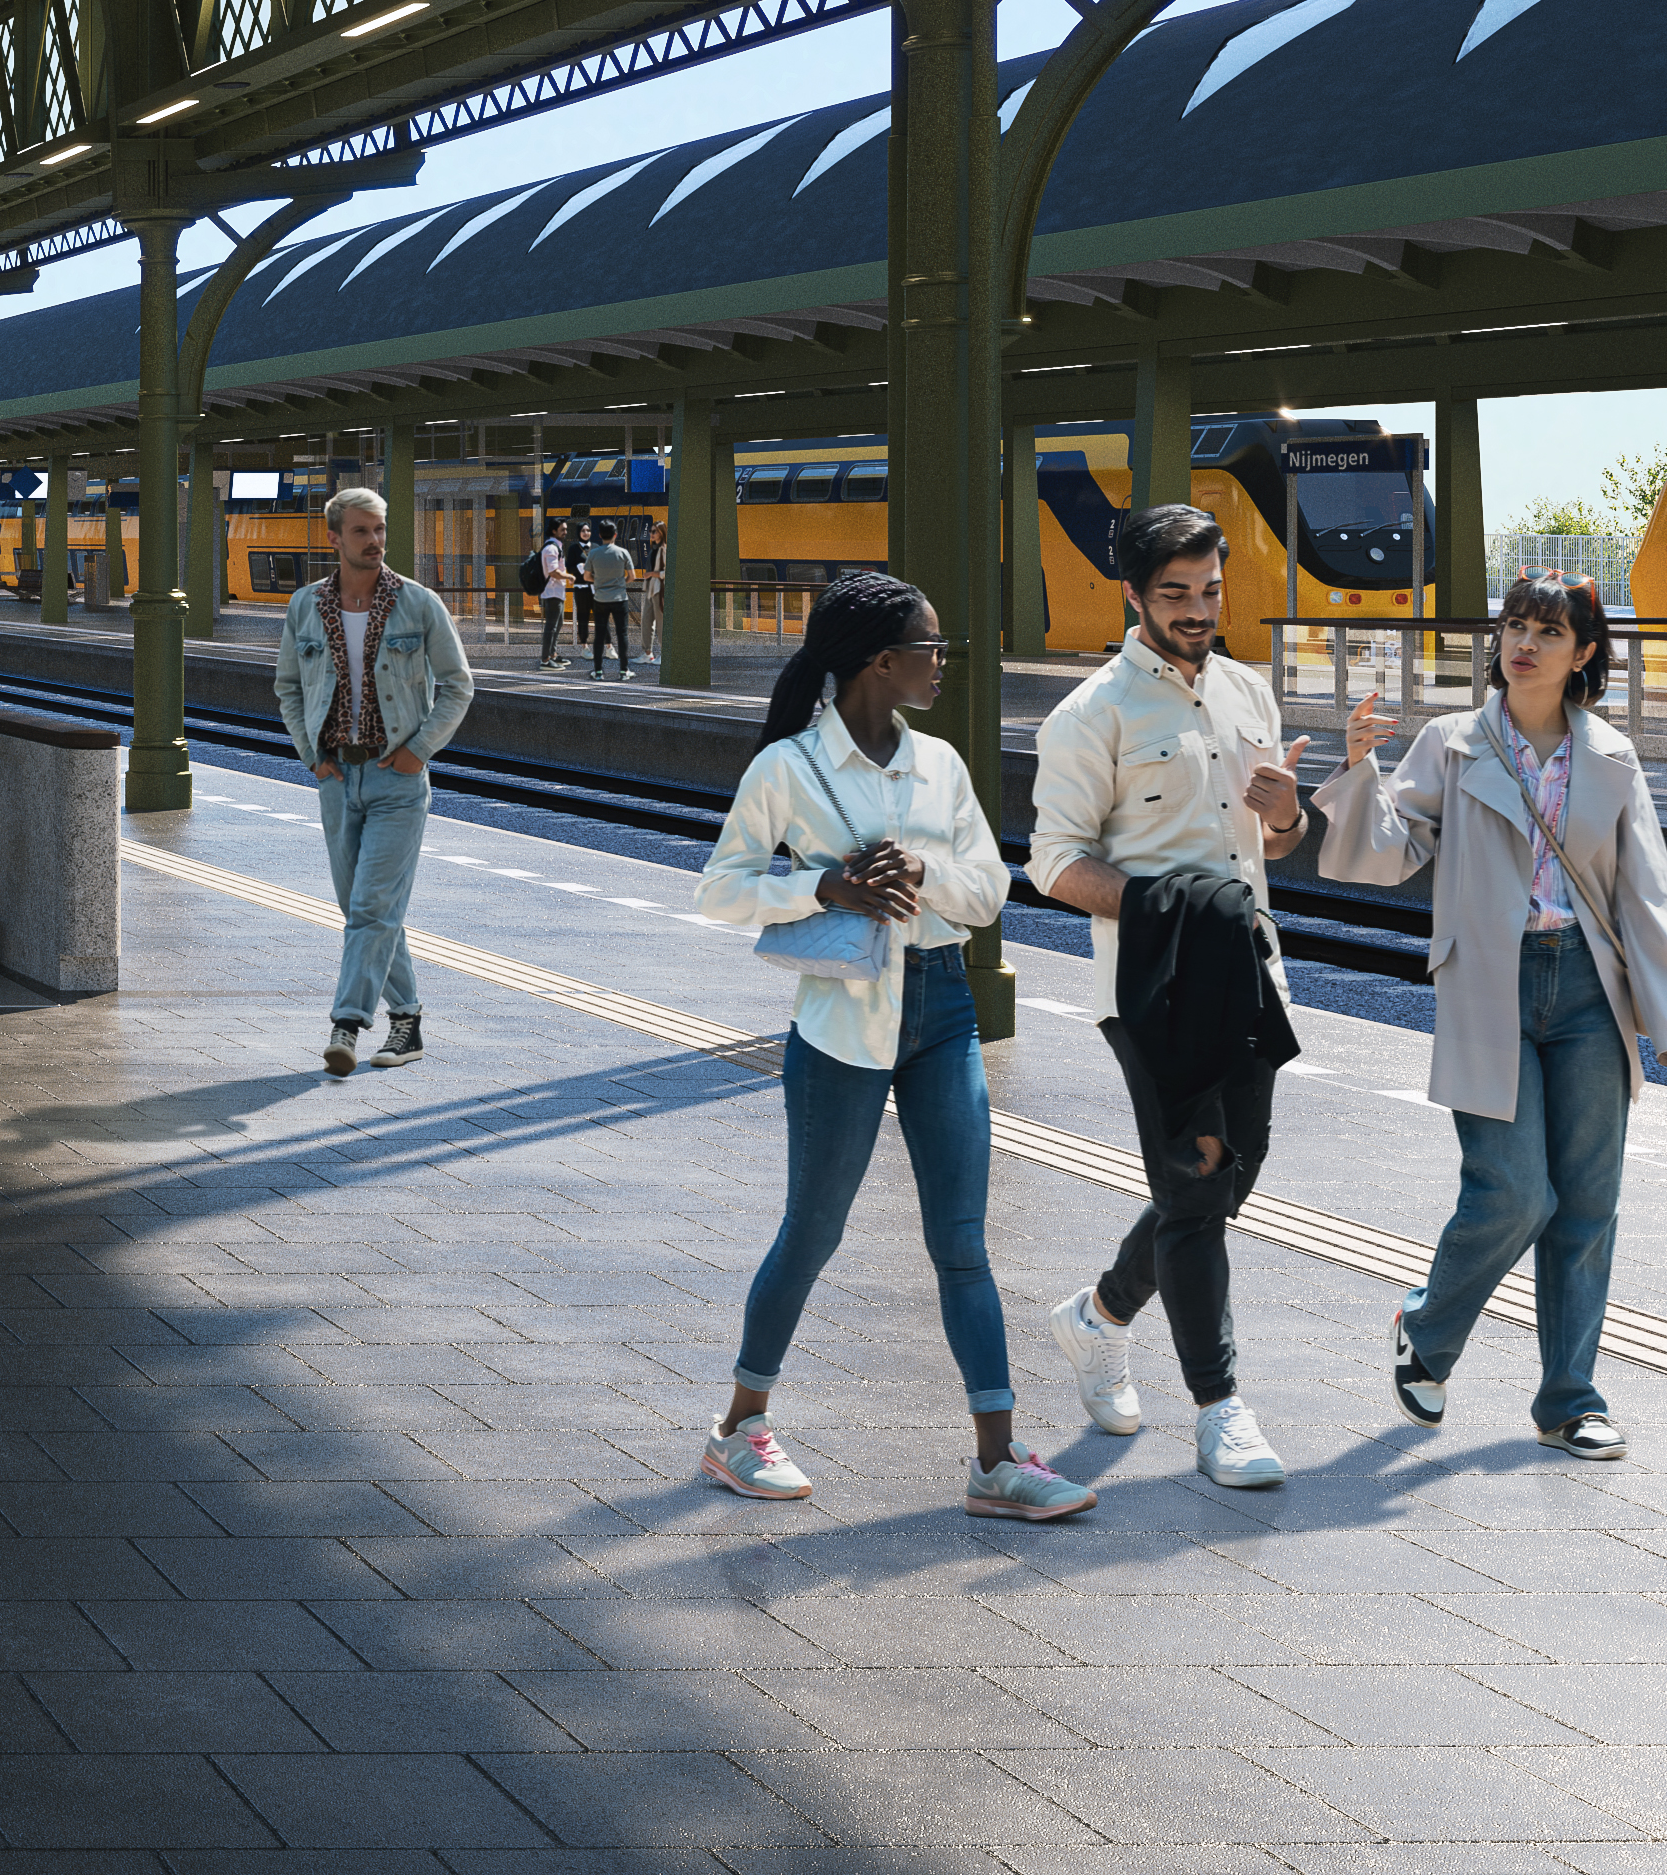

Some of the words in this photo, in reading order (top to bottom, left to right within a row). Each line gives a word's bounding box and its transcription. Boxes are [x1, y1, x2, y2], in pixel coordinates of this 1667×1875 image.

[1289, 450, 1369, 471] Nijmegen
[1109, 519, 1116, 529] 2
[1108, 545, 1114, 555] 2
